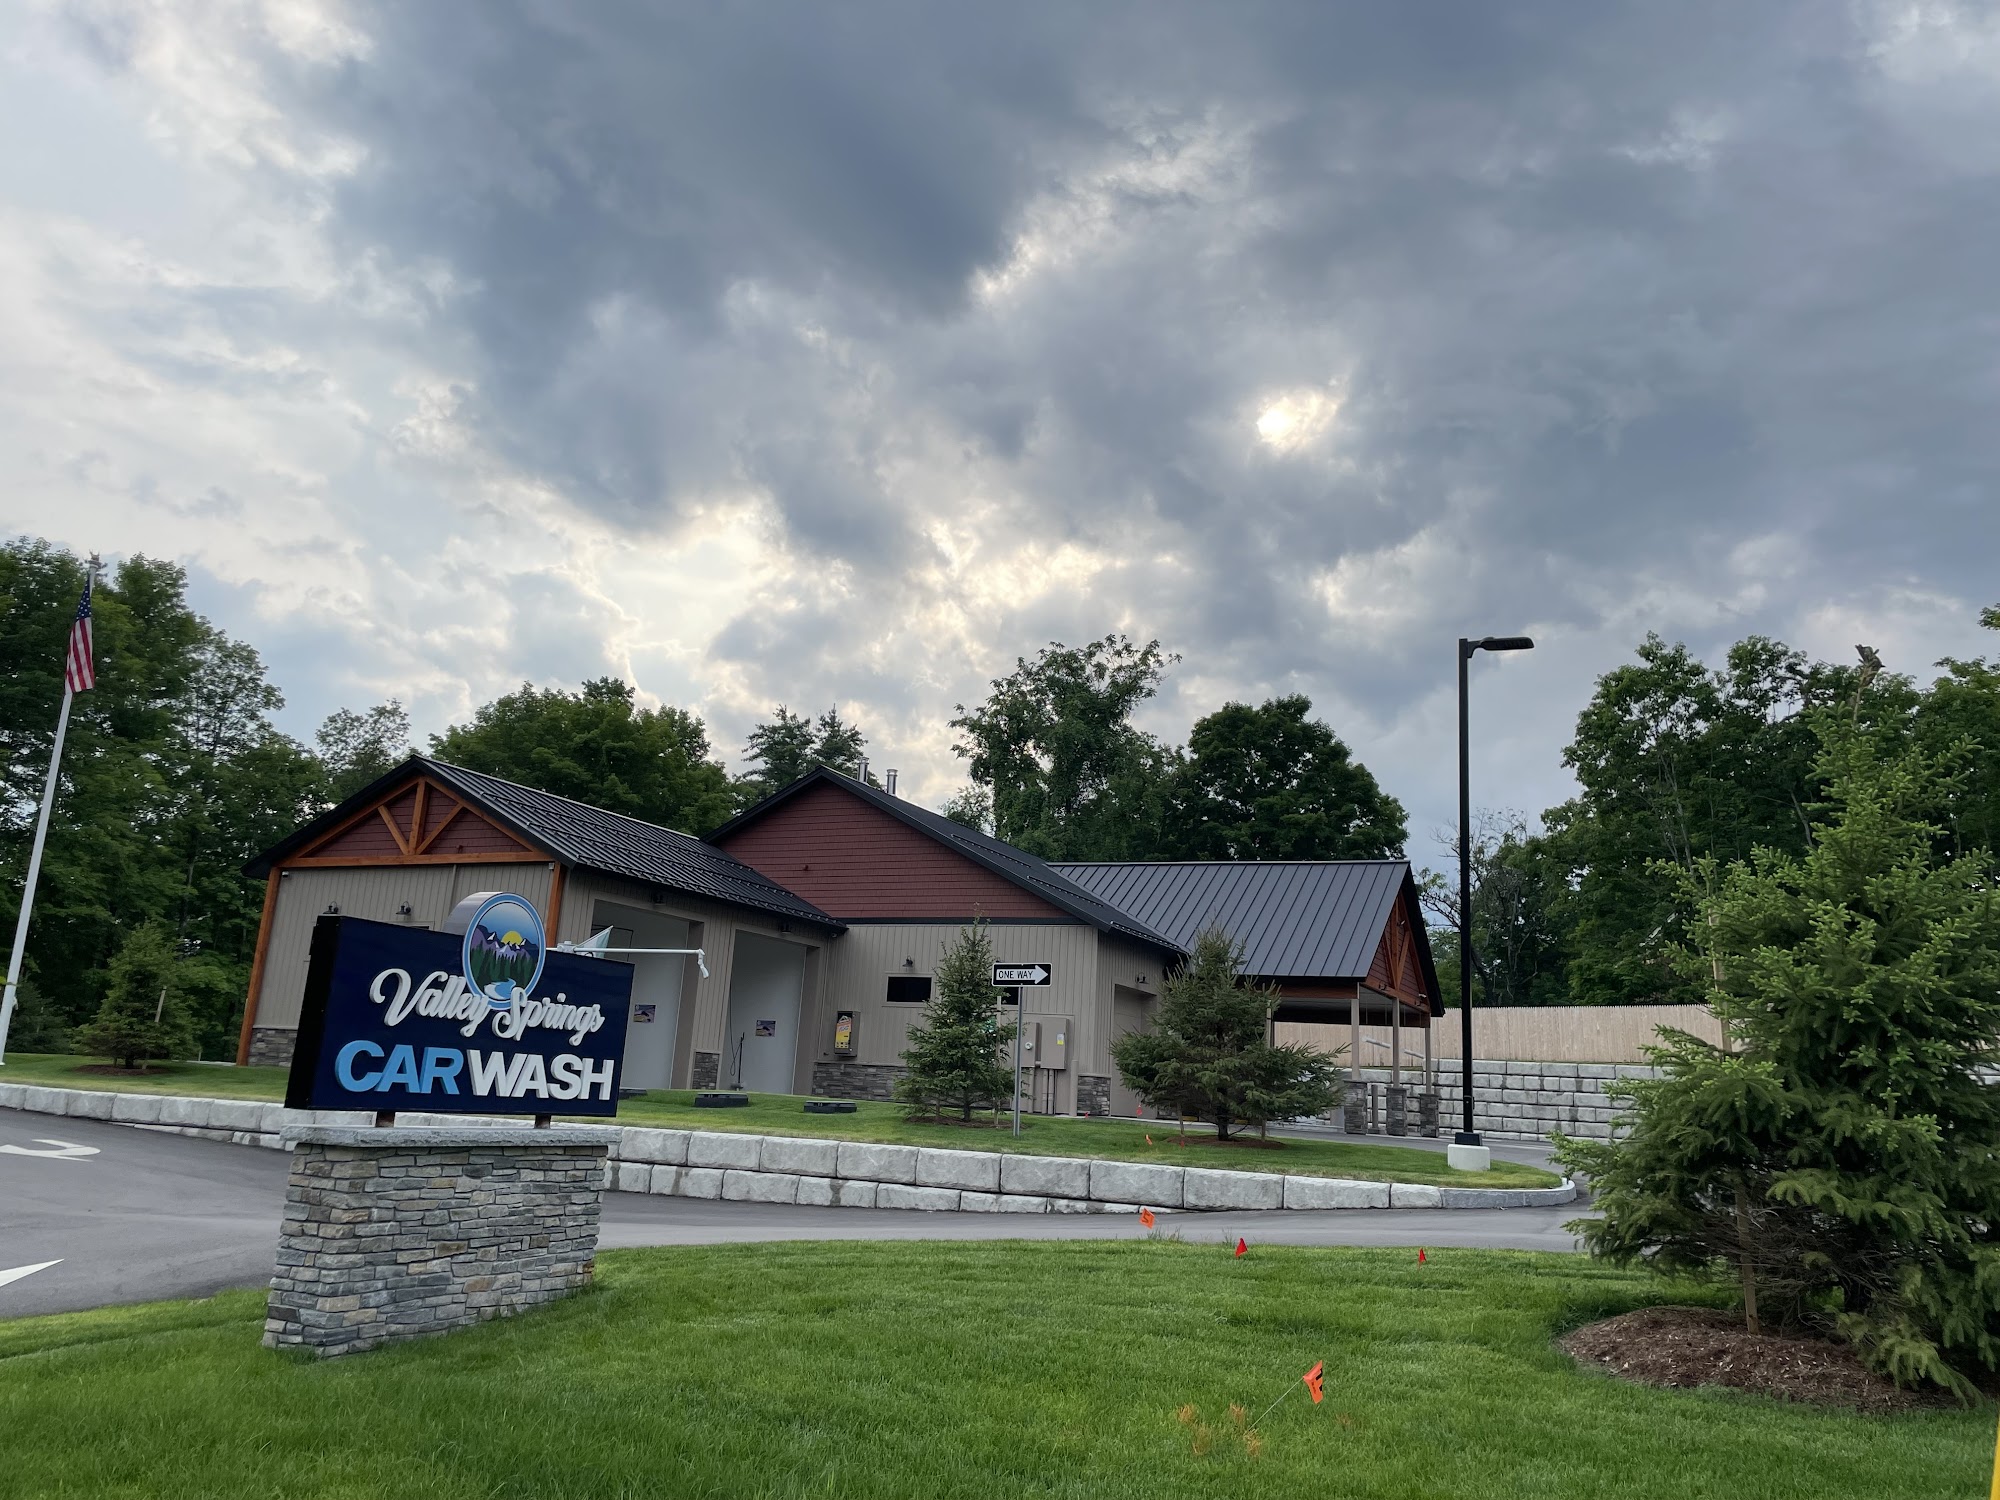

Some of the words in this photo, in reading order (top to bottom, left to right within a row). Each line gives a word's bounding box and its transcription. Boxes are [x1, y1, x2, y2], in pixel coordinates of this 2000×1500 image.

[998, 970, 1014, 979] ONE
[1016, 970, 1034, 979] WAY
[369, 968, 491, 1037] Valley
[492, 986, 605, 1046] Springs
[335, 1039, 464, 1095] CAR
[467, 1049, 615, 1101] WASH
